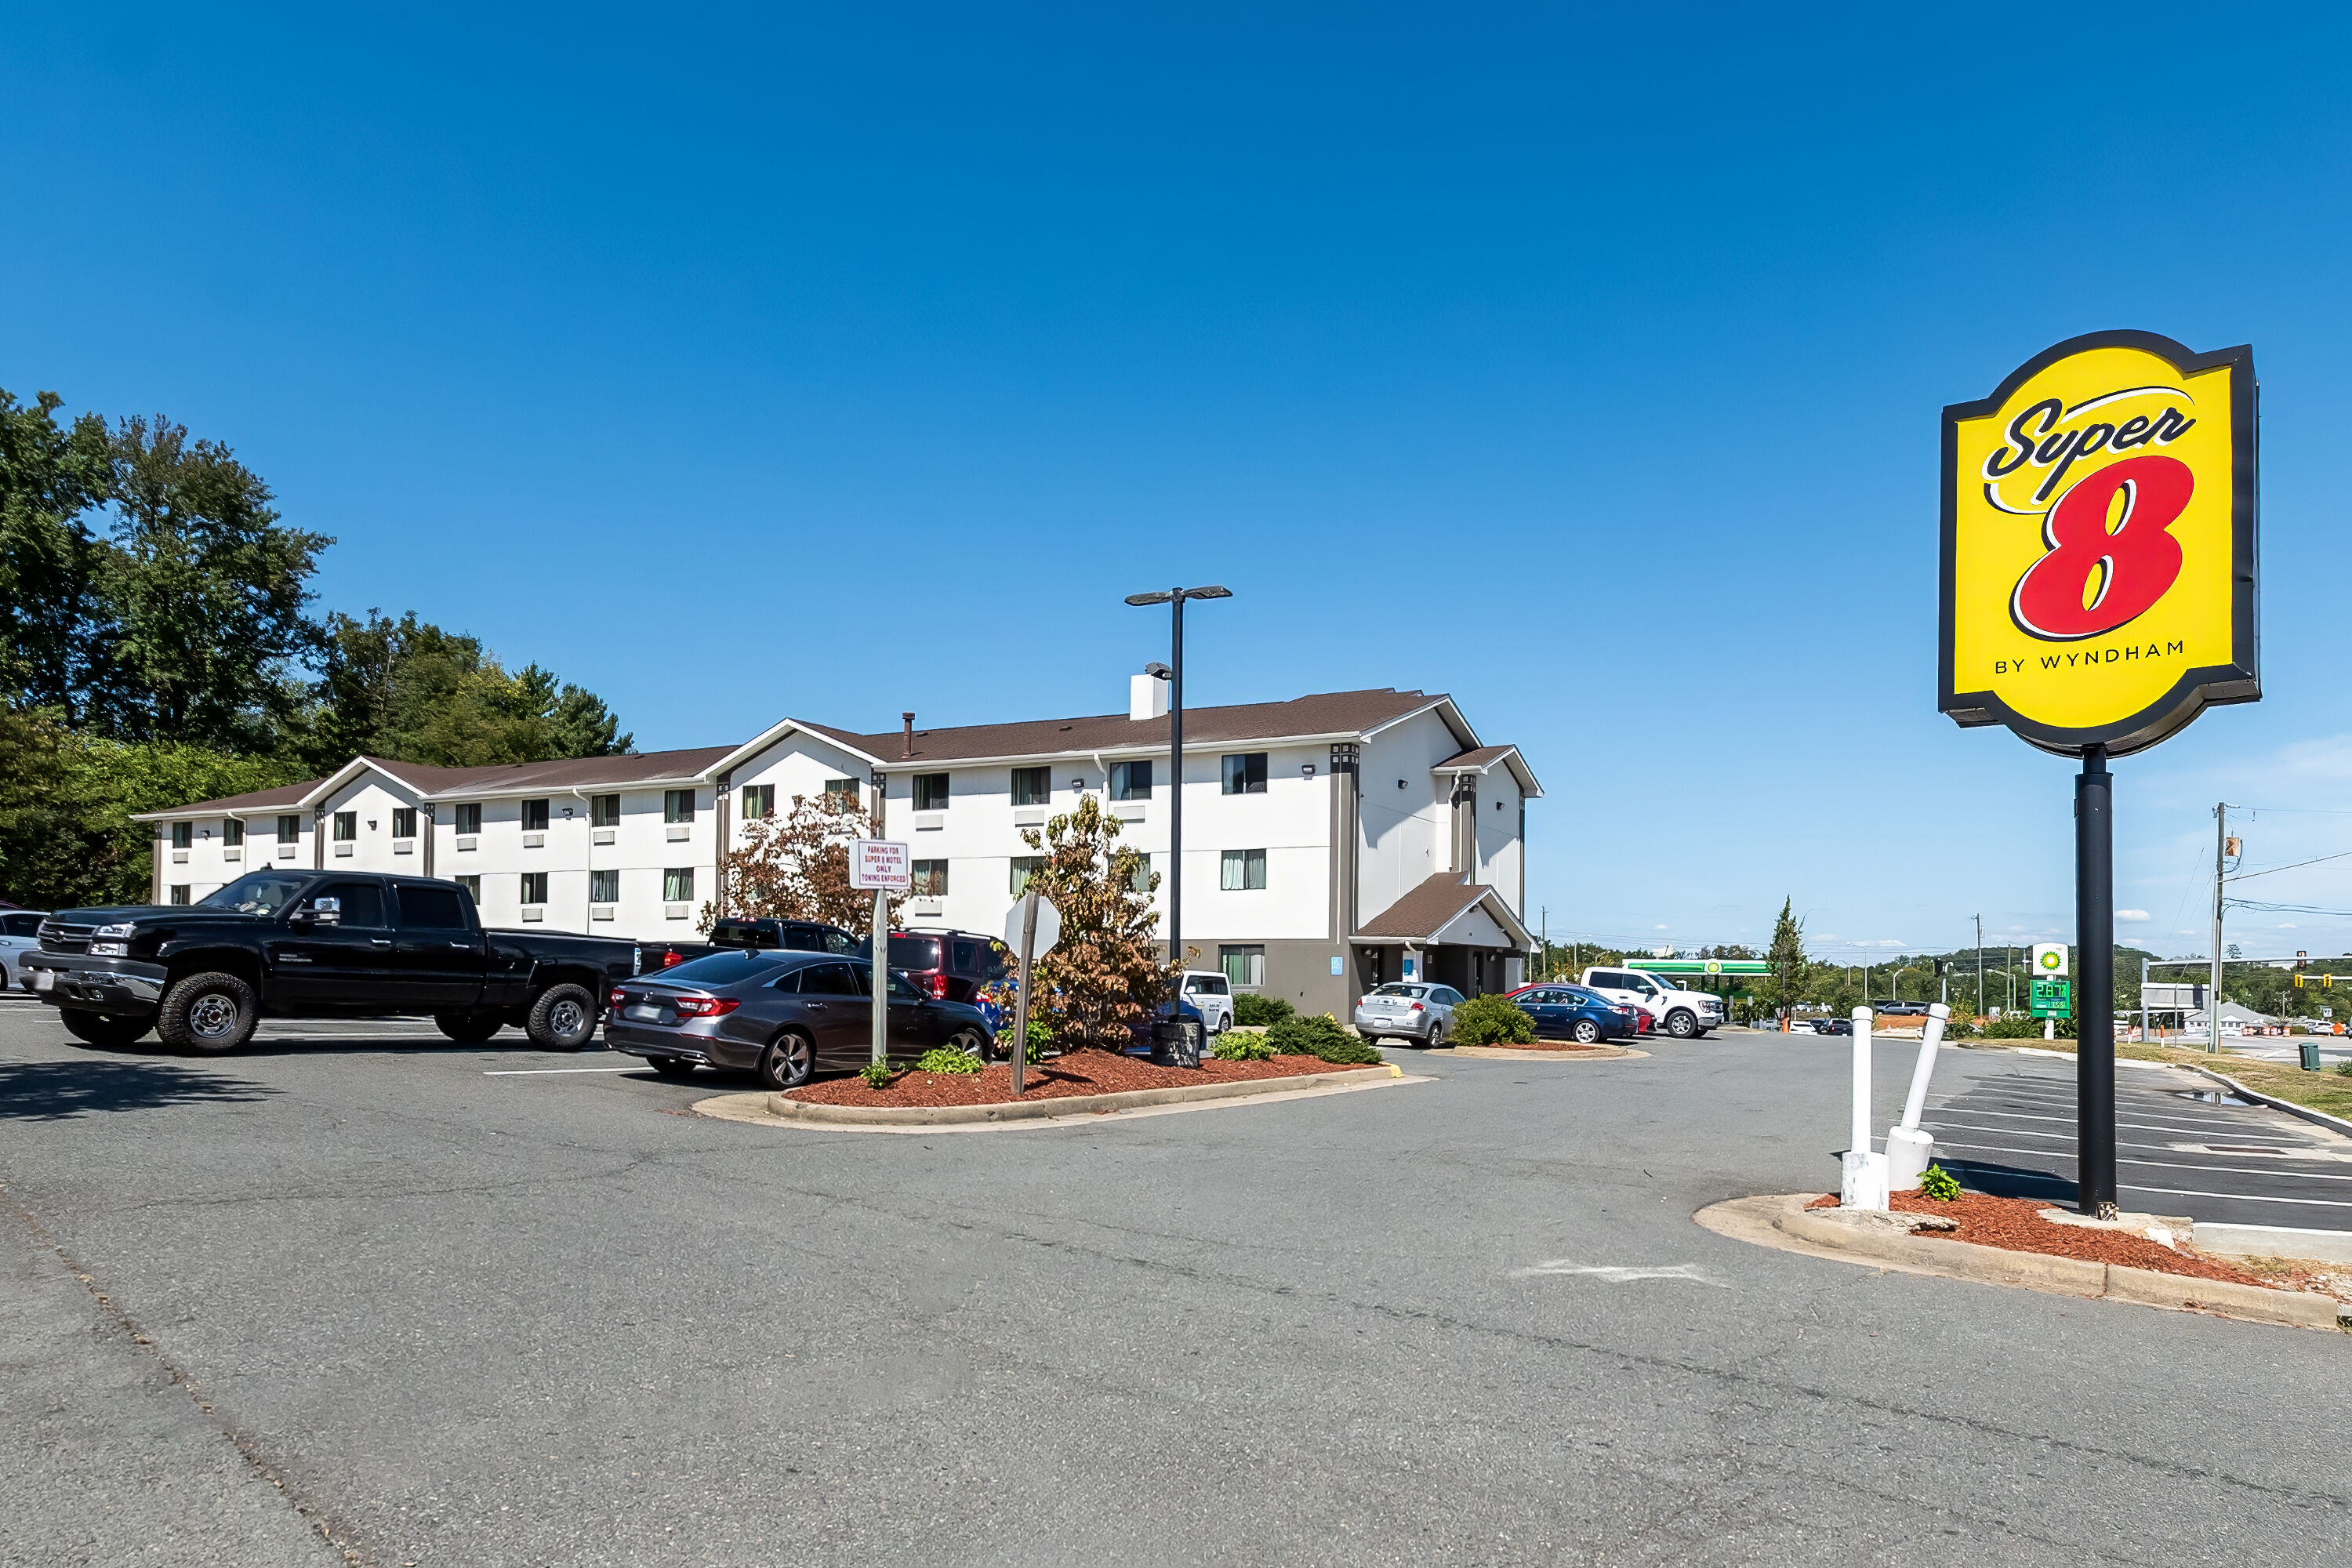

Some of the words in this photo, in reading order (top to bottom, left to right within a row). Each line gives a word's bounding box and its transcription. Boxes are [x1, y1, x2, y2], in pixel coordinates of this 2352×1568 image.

[1982, 397, 2197, 506] Super
[2009, 455, 2194, 643] 8
[1995, 659, 2025, 674] BY
[2040, 640, 2183, 670] WYNDHAM
[868, 845, 887, 854] PARKING
